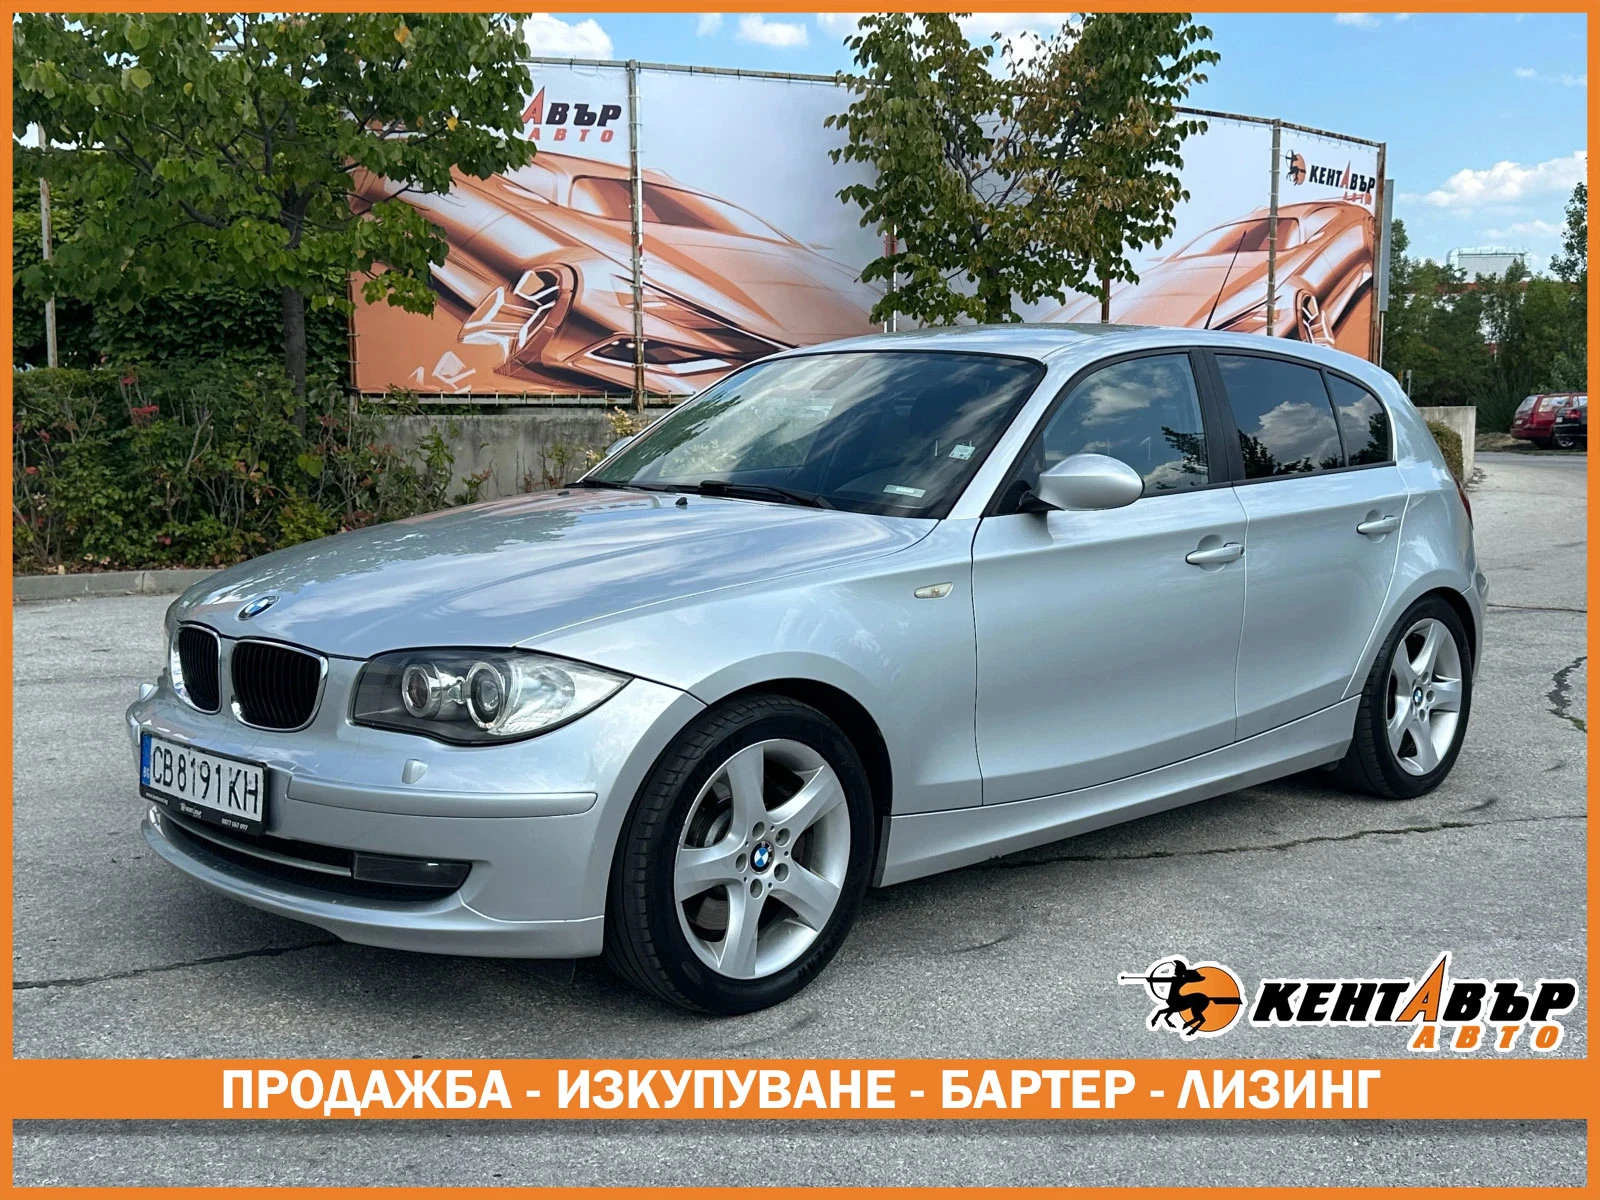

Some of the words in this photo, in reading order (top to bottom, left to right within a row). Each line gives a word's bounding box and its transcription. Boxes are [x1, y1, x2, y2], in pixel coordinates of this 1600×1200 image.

[521, 85, 622, 127] АВЪР
[528, 127, 614, 143] АВТО
[1309, 160, 1376, 194] КЕНТАВЪР
